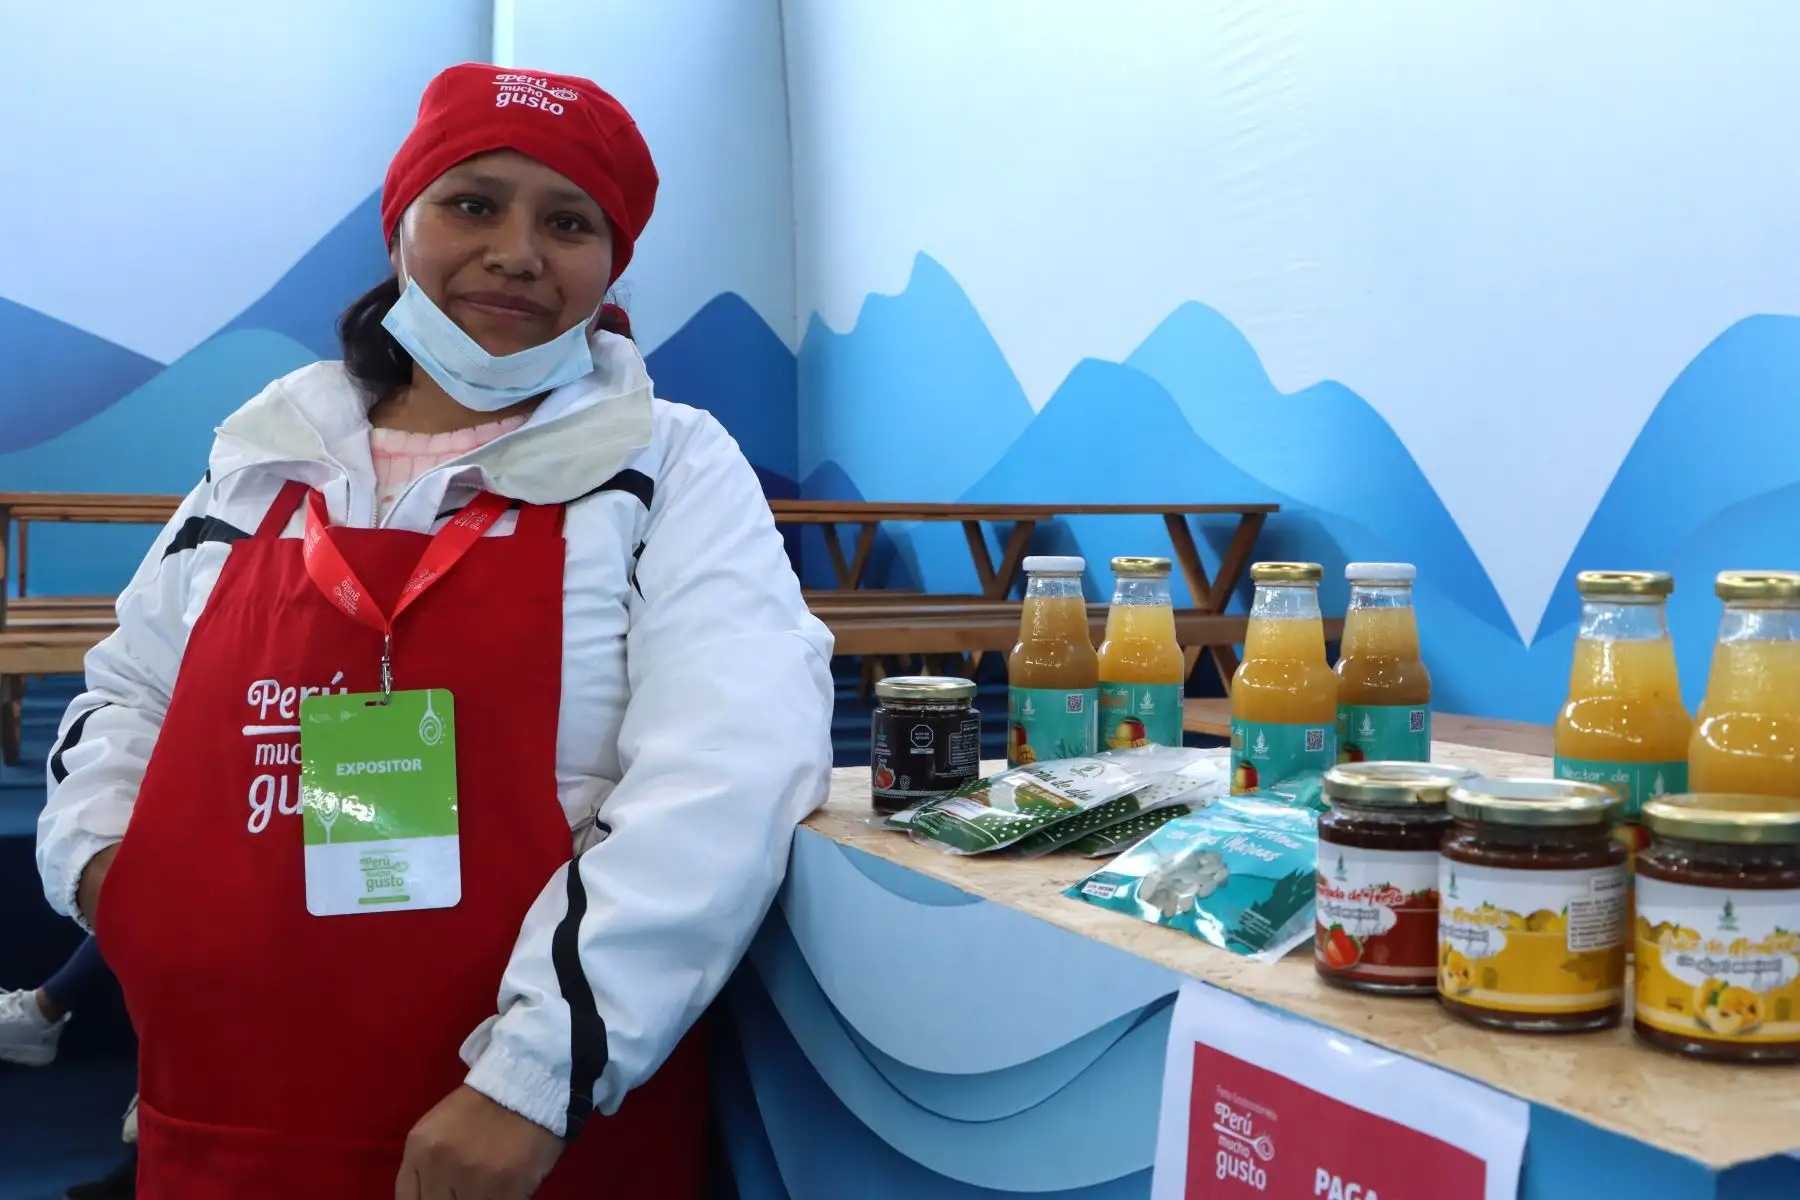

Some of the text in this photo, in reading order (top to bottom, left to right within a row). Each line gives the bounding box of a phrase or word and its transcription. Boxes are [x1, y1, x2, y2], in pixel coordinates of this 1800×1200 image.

[495, 91, 565, 115] gusto
[500, 85, 544, 98] mucho
[255, 743, 302, 766] muc
[335, 758, 422, 776] EXPOSITOR
[1611, 768, 1630, 782] de
[366, 871, 405, 892] gusto
[1214, 1102, 1253, 1134] Perú
[1218, 1133, 1250, 1158] mucho
[1216, 1150, 1266, 1191] gusto
